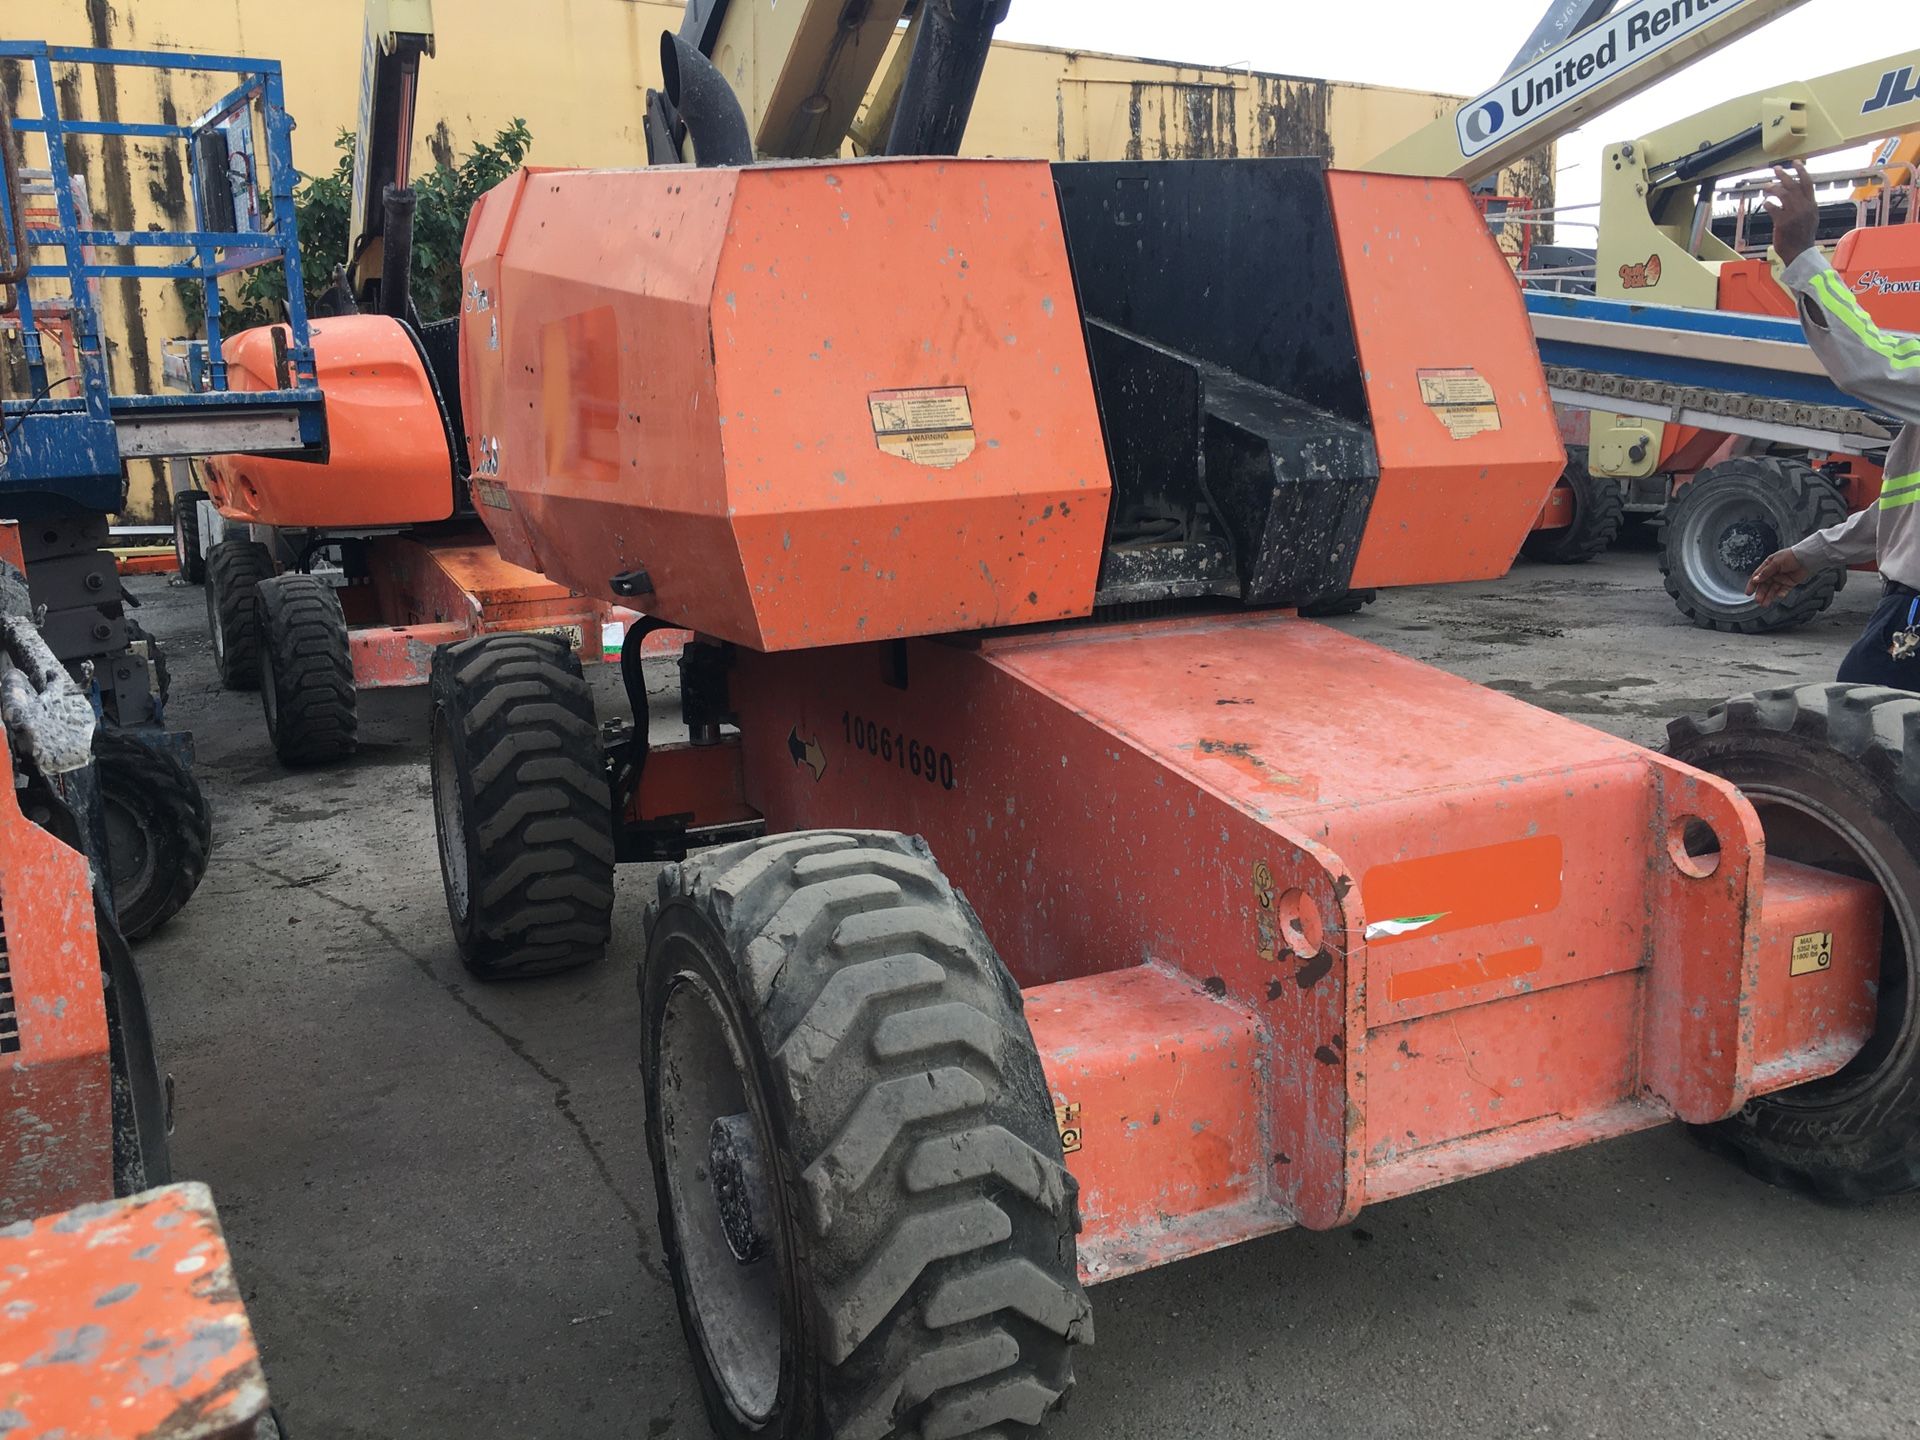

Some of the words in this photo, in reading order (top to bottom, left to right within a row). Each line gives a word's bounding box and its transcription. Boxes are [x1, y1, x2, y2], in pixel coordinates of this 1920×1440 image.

[1555, 0, 1580, 30] SJ61
[1511, 28, 1616, 118] United
[1860, 64, 1920, 115] JL
[912, 432, 949, 441] WARNING
[843, 710, 953, 790] 10061690
